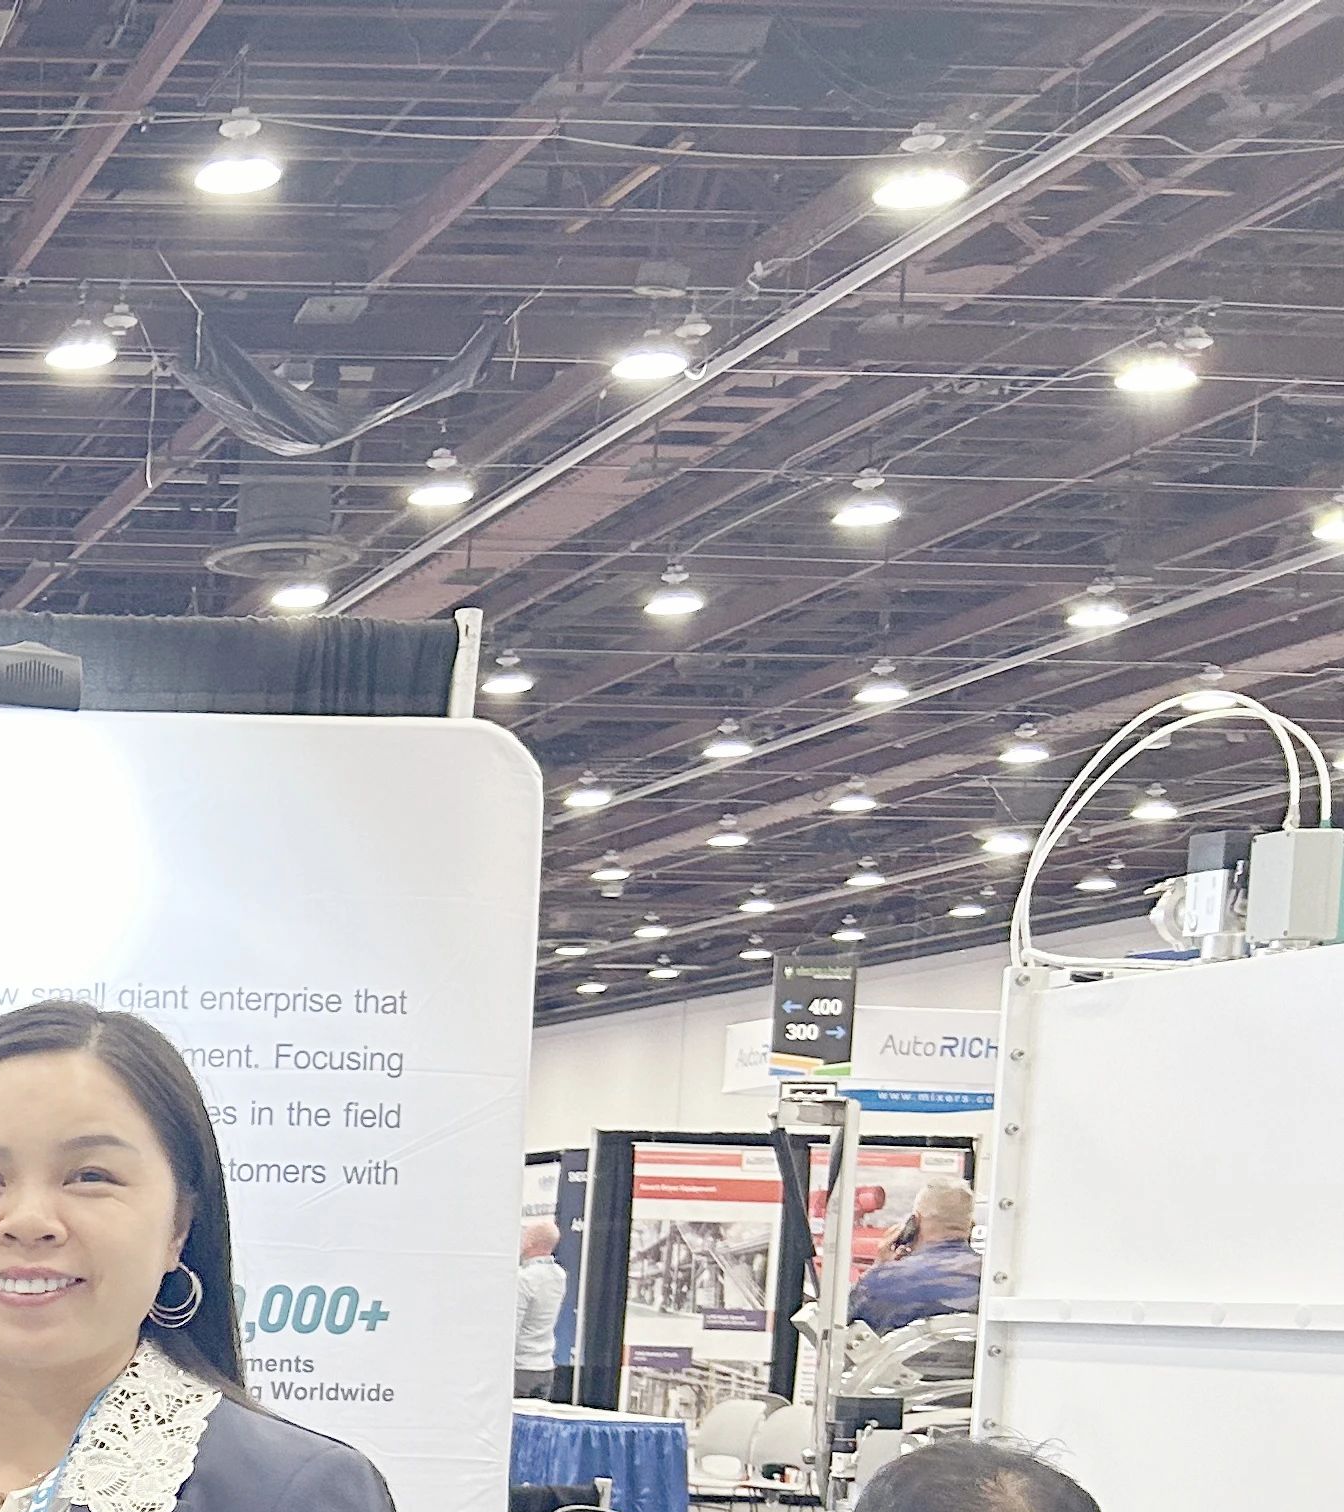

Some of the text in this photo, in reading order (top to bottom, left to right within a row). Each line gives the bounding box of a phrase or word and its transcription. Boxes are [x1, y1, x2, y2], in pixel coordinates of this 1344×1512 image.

[118, 984, 189, 1013] giant
[200, 988, 343, 1018] enterprise
[354, 988, 408, 1016] that
[808, 998, 843, 1016] 400
[784, 1023, 820, 1042] 300
[274, 1042, 405, 1079] Focusing
[251, 1101, 274, 1127] in
[286, 1102, 331, 1128] the
[343, 1102, 402, 1129] field
[220, 1158, 327, 1185] tomers
[343, 1160, 399, 1186] with
[270, 1381, 396, 1402] Worldwide
